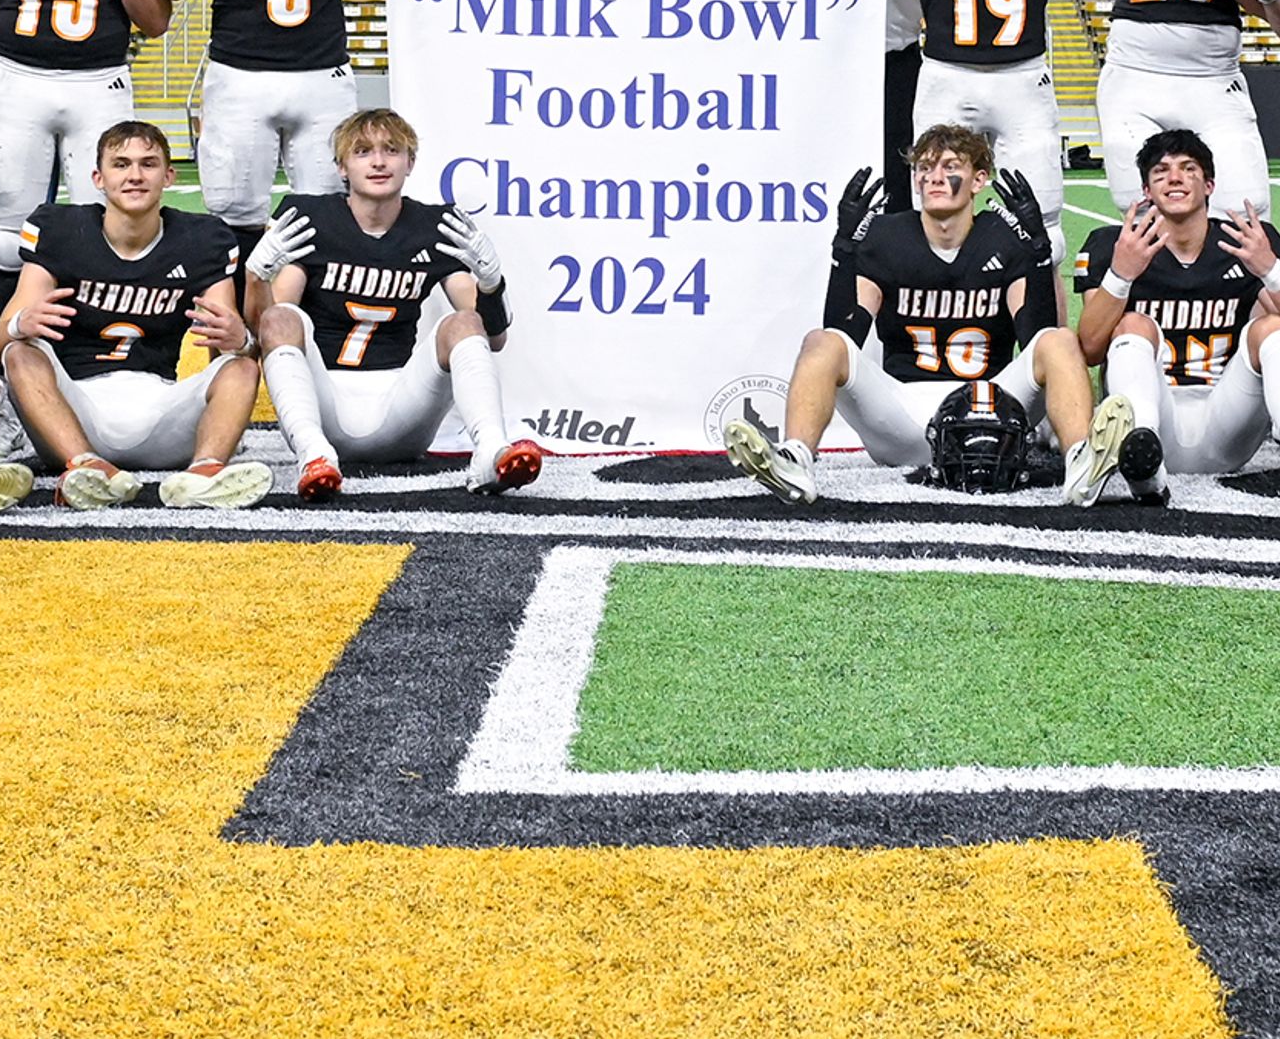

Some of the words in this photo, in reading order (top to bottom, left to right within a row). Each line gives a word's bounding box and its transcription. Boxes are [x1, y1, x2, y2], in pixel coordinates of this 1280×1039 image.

[485, 66, 781, 132] Football
[439, 157, 828, 239] Champions
[76, 279, 185, 316] KENDRICK
[321, 262, 427, 300] KENDRICK
[547, 255, 711, 316] 2024
[897, 286, 1002, 320] KENDRICK
[336, 300, 397, 367] 7
[710, 386, 738, 415] Idaho
[741, 379, 773, 389] High
